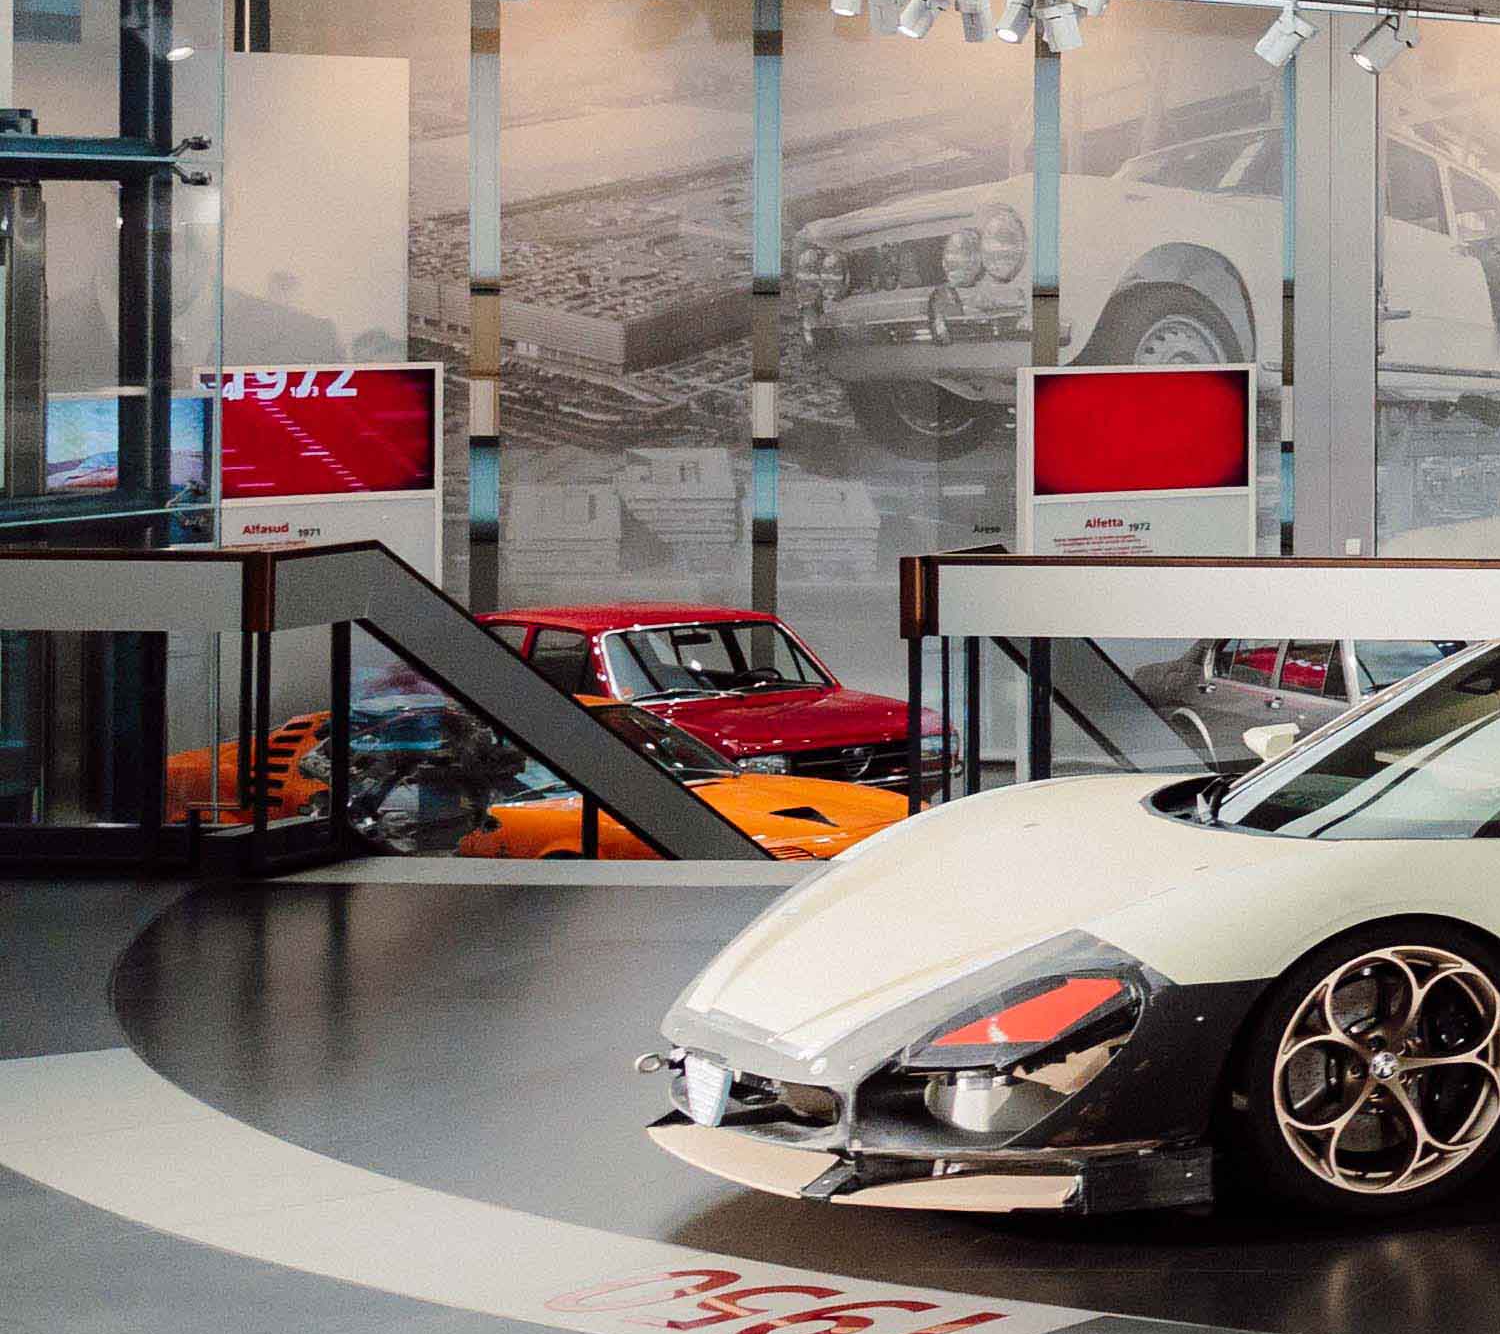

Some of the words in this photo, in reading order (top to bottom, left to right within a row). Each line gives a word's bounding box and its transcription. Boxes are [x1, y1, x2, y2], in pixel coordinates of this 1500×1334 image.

[242, 522, 290, 535] Alfasud
[298, 528, 321, 538] 1971
[1084, 517, 1124, 529] Alfetta
[1128, 522, 1151, 532] 1972
